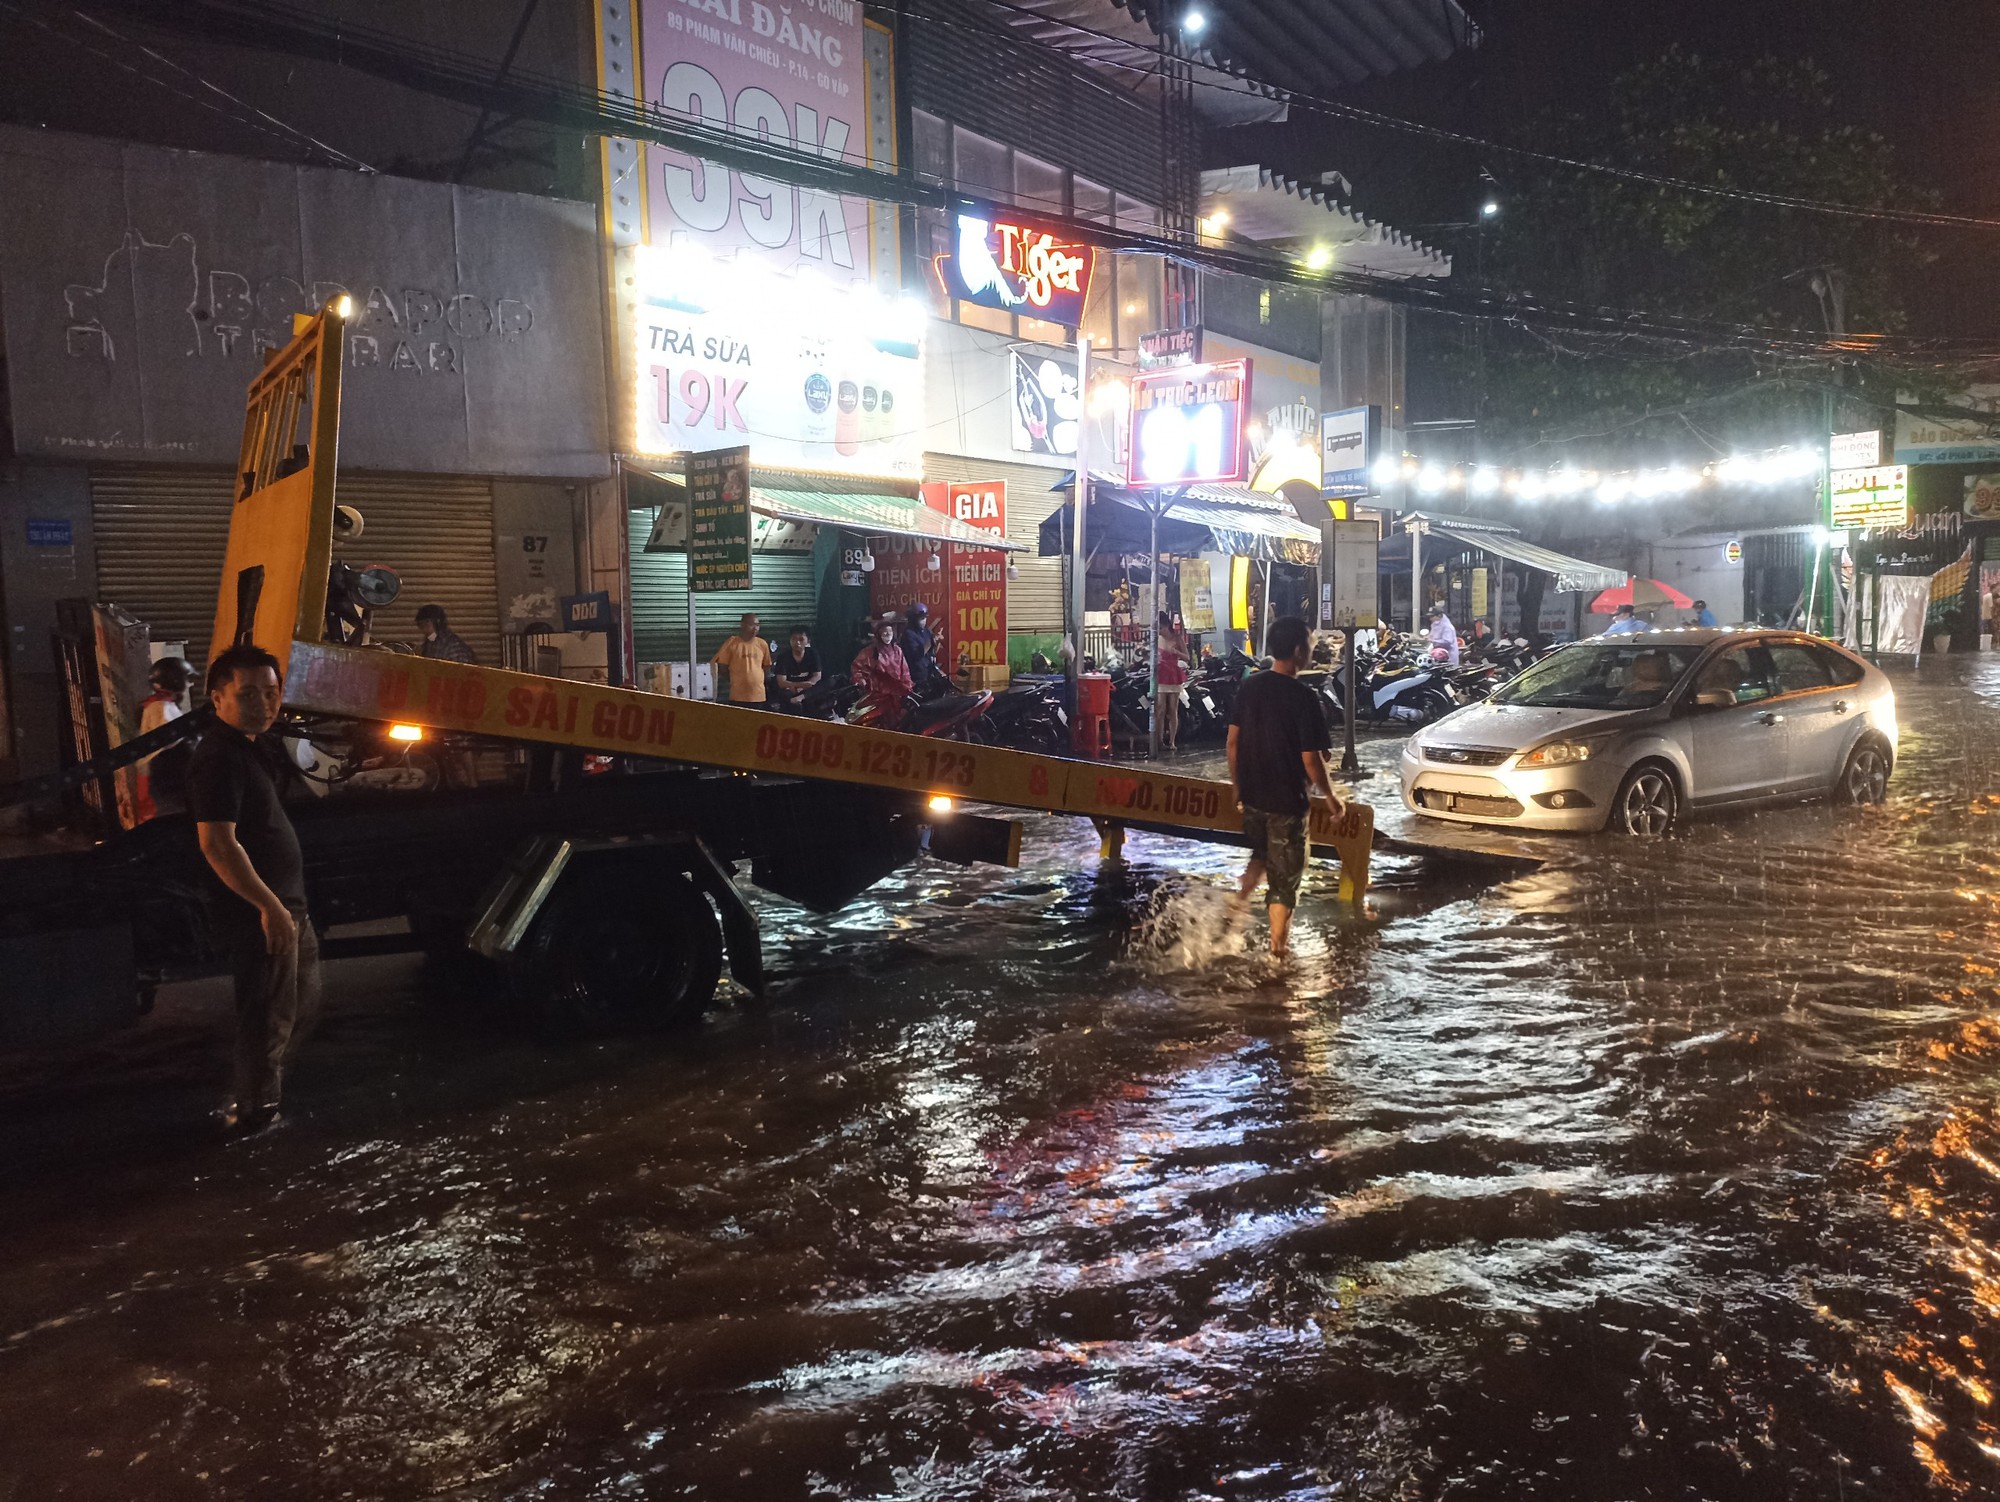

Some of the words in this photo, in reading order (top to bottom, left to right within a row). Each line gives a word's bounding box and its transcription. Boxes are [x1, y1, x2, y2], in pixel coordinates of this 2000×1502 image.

[667, 11, 683, 32] 89
[686, 18, 721, 46] PHẠM
[723, 31, 746, 56] VĂN
[789, 60, 809, 81] P.14
[751, 2, 844, 68] ĐĂNG
[661, 61, 855, 270] 39K
[994, 223, 1084, 307] Tiger
[648, 325, 695, 357] TRÀ
[703, 334, 752, 367] SỮA
[649, 364, 749, 433] 19K
[955, 491, 999, 521] GIA
[523, 535, 548, 553] 87
[844, 548, 864, 565] 89
[877, 566, 913, 589] TIỆN
[915, 564, 943, 584] ÍCH
[954, 561, 979, 587] TIỆN
[982, 560, 1001, 582] ÍCH
[956, 589, 971, 602] GIÁ
[972, 588, 989, 601] CHỈ
[989, 588, 1003, 600] TỪ
[957, 606, 999, 632] 10K
[957, 639, 999, 665] 20K
[425, 670, 487, 730] HỘ
[504, 682, 580, 733] SÀI
[591, 690, 676, 747] GÒN
[755, 722, 978, 788] 0909.123.123
